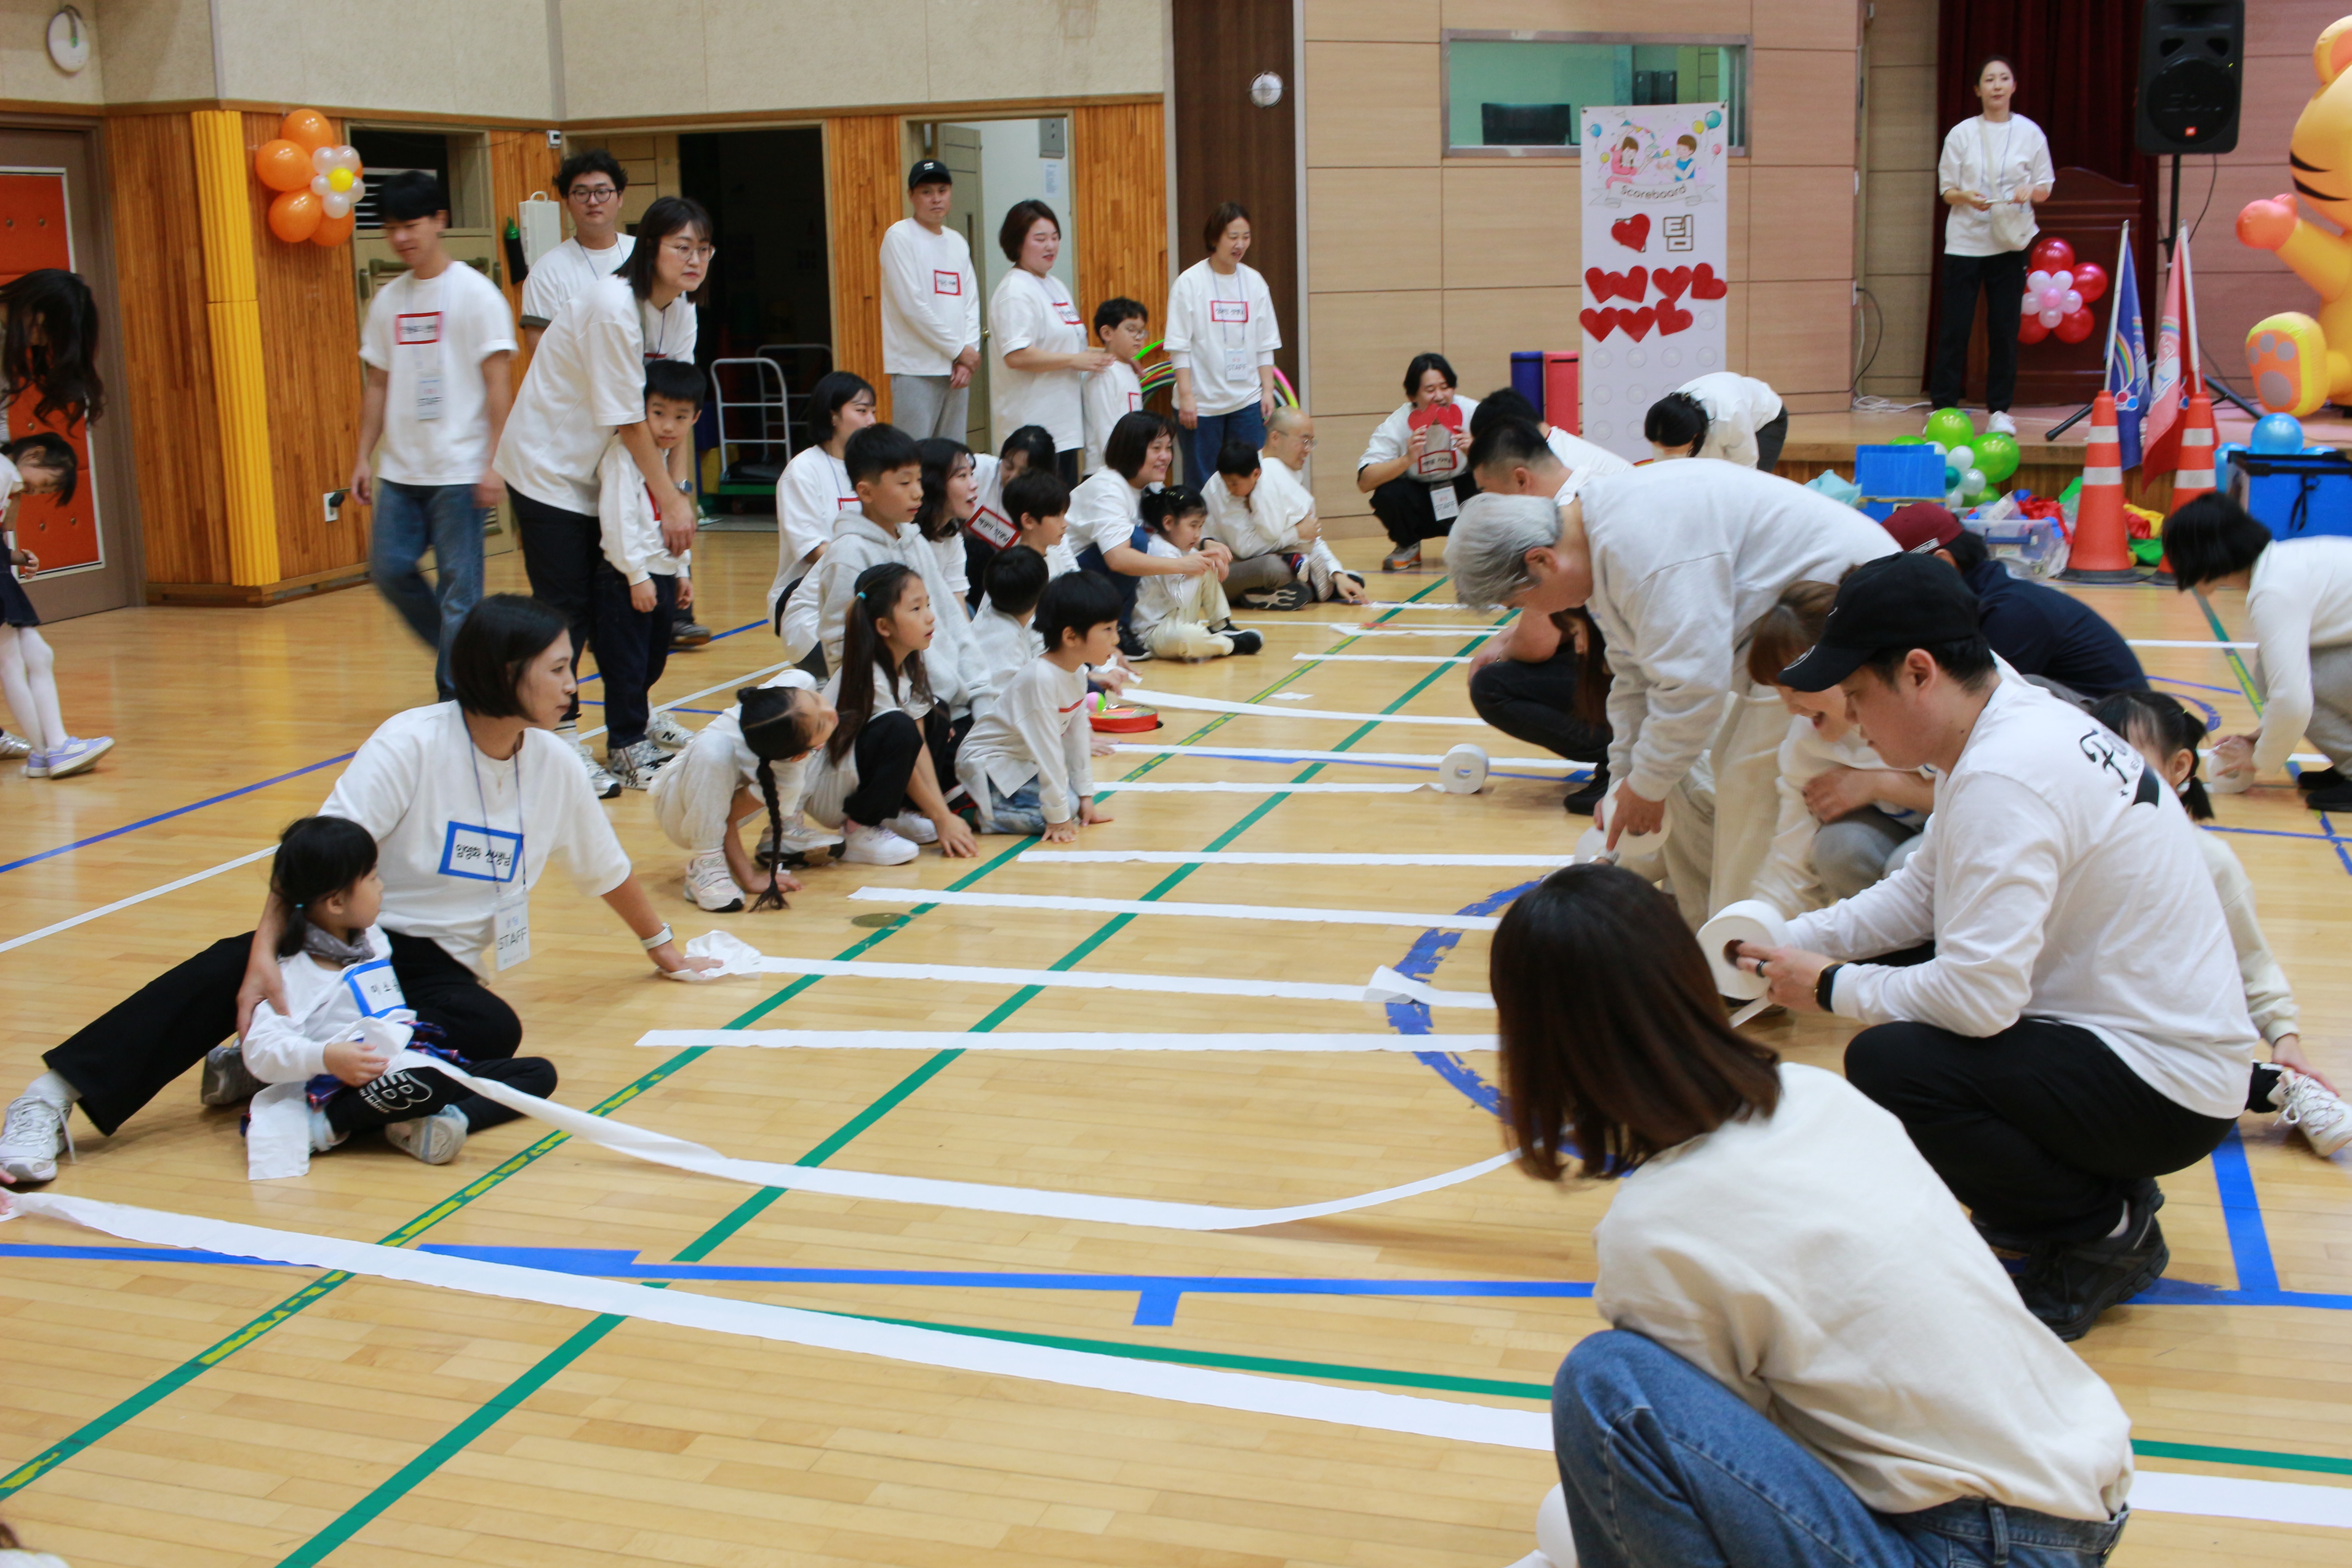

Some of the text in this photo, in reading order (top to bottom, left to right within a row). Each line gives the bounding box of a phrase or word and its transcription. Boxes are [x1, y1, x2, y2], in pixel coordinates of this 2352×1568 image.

[1620, 183, 1686, 200] Scoreboard
[1663, 214, 1693, 252] 팀
[485, 849, 512, 866] 선생님
[497, 926, 527, 951] STAFF
